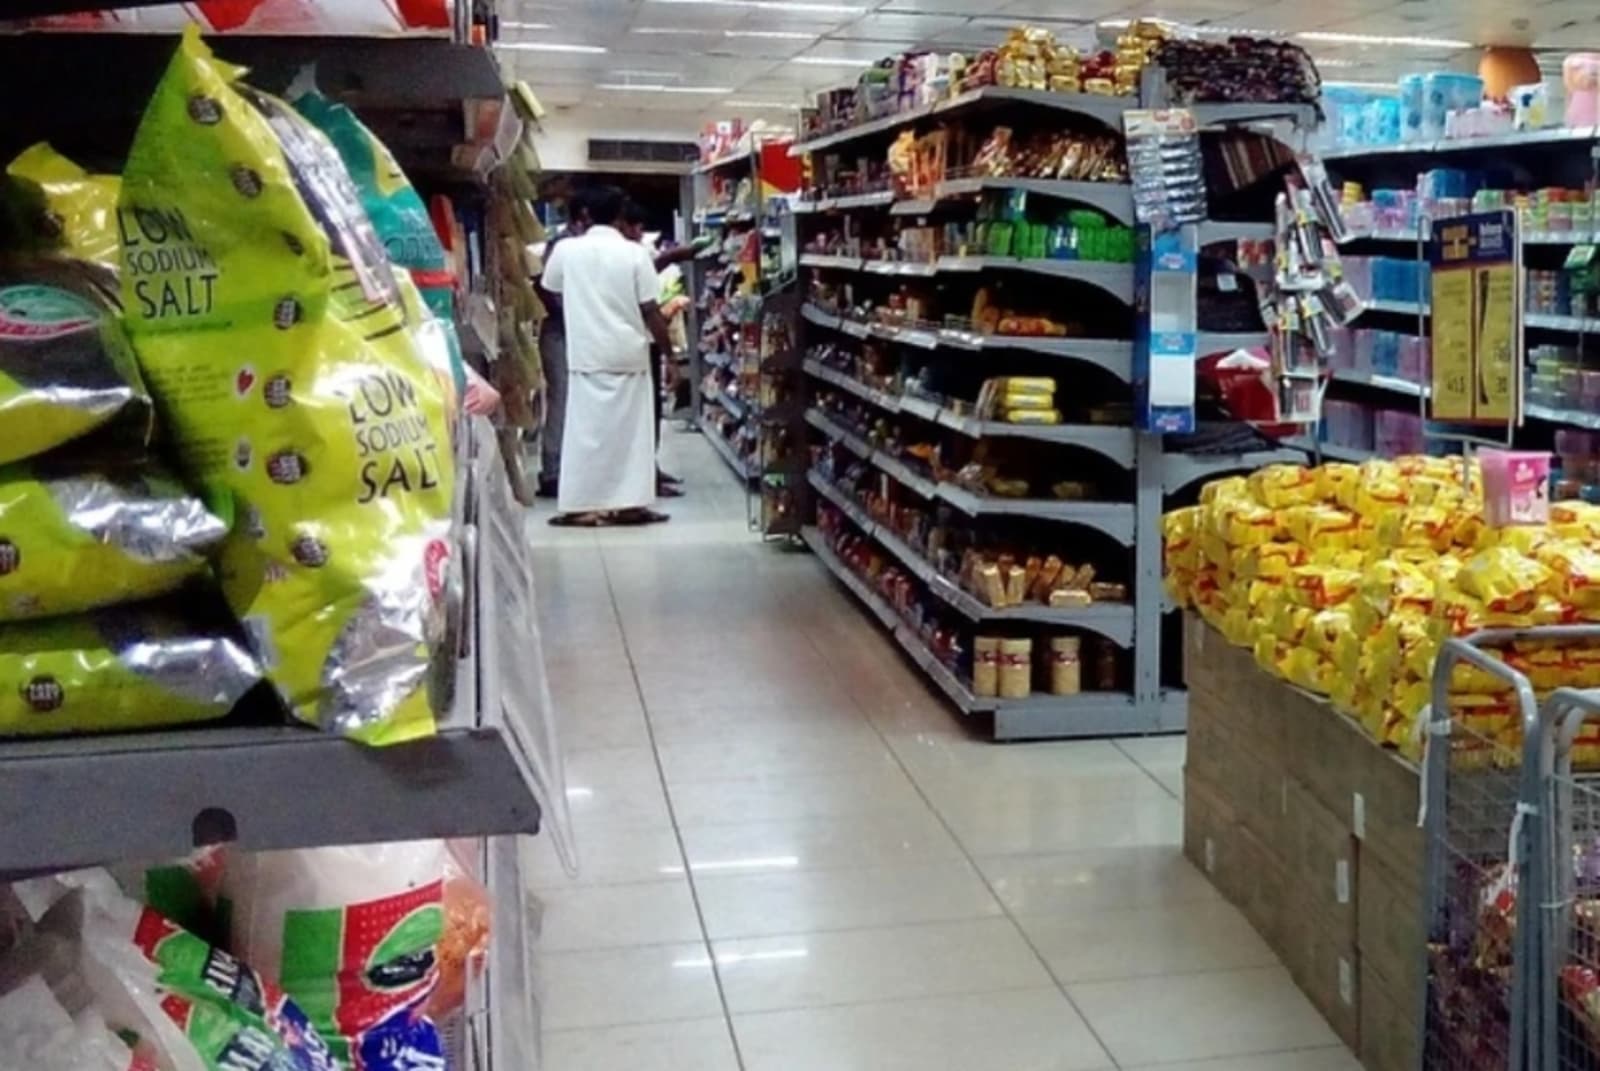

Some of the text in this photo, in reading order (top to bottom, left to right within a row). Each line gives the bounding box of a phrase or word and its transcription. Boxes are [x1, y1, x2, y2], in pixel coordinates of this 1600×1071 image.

[116, 206, 193, 247] LOW
[126, 247, 217, 276] SODIUM
[135, 274, 218, 318] SALT
[340, 372, 417, 425] LOW
[358, 444, 440, 504] SALT
